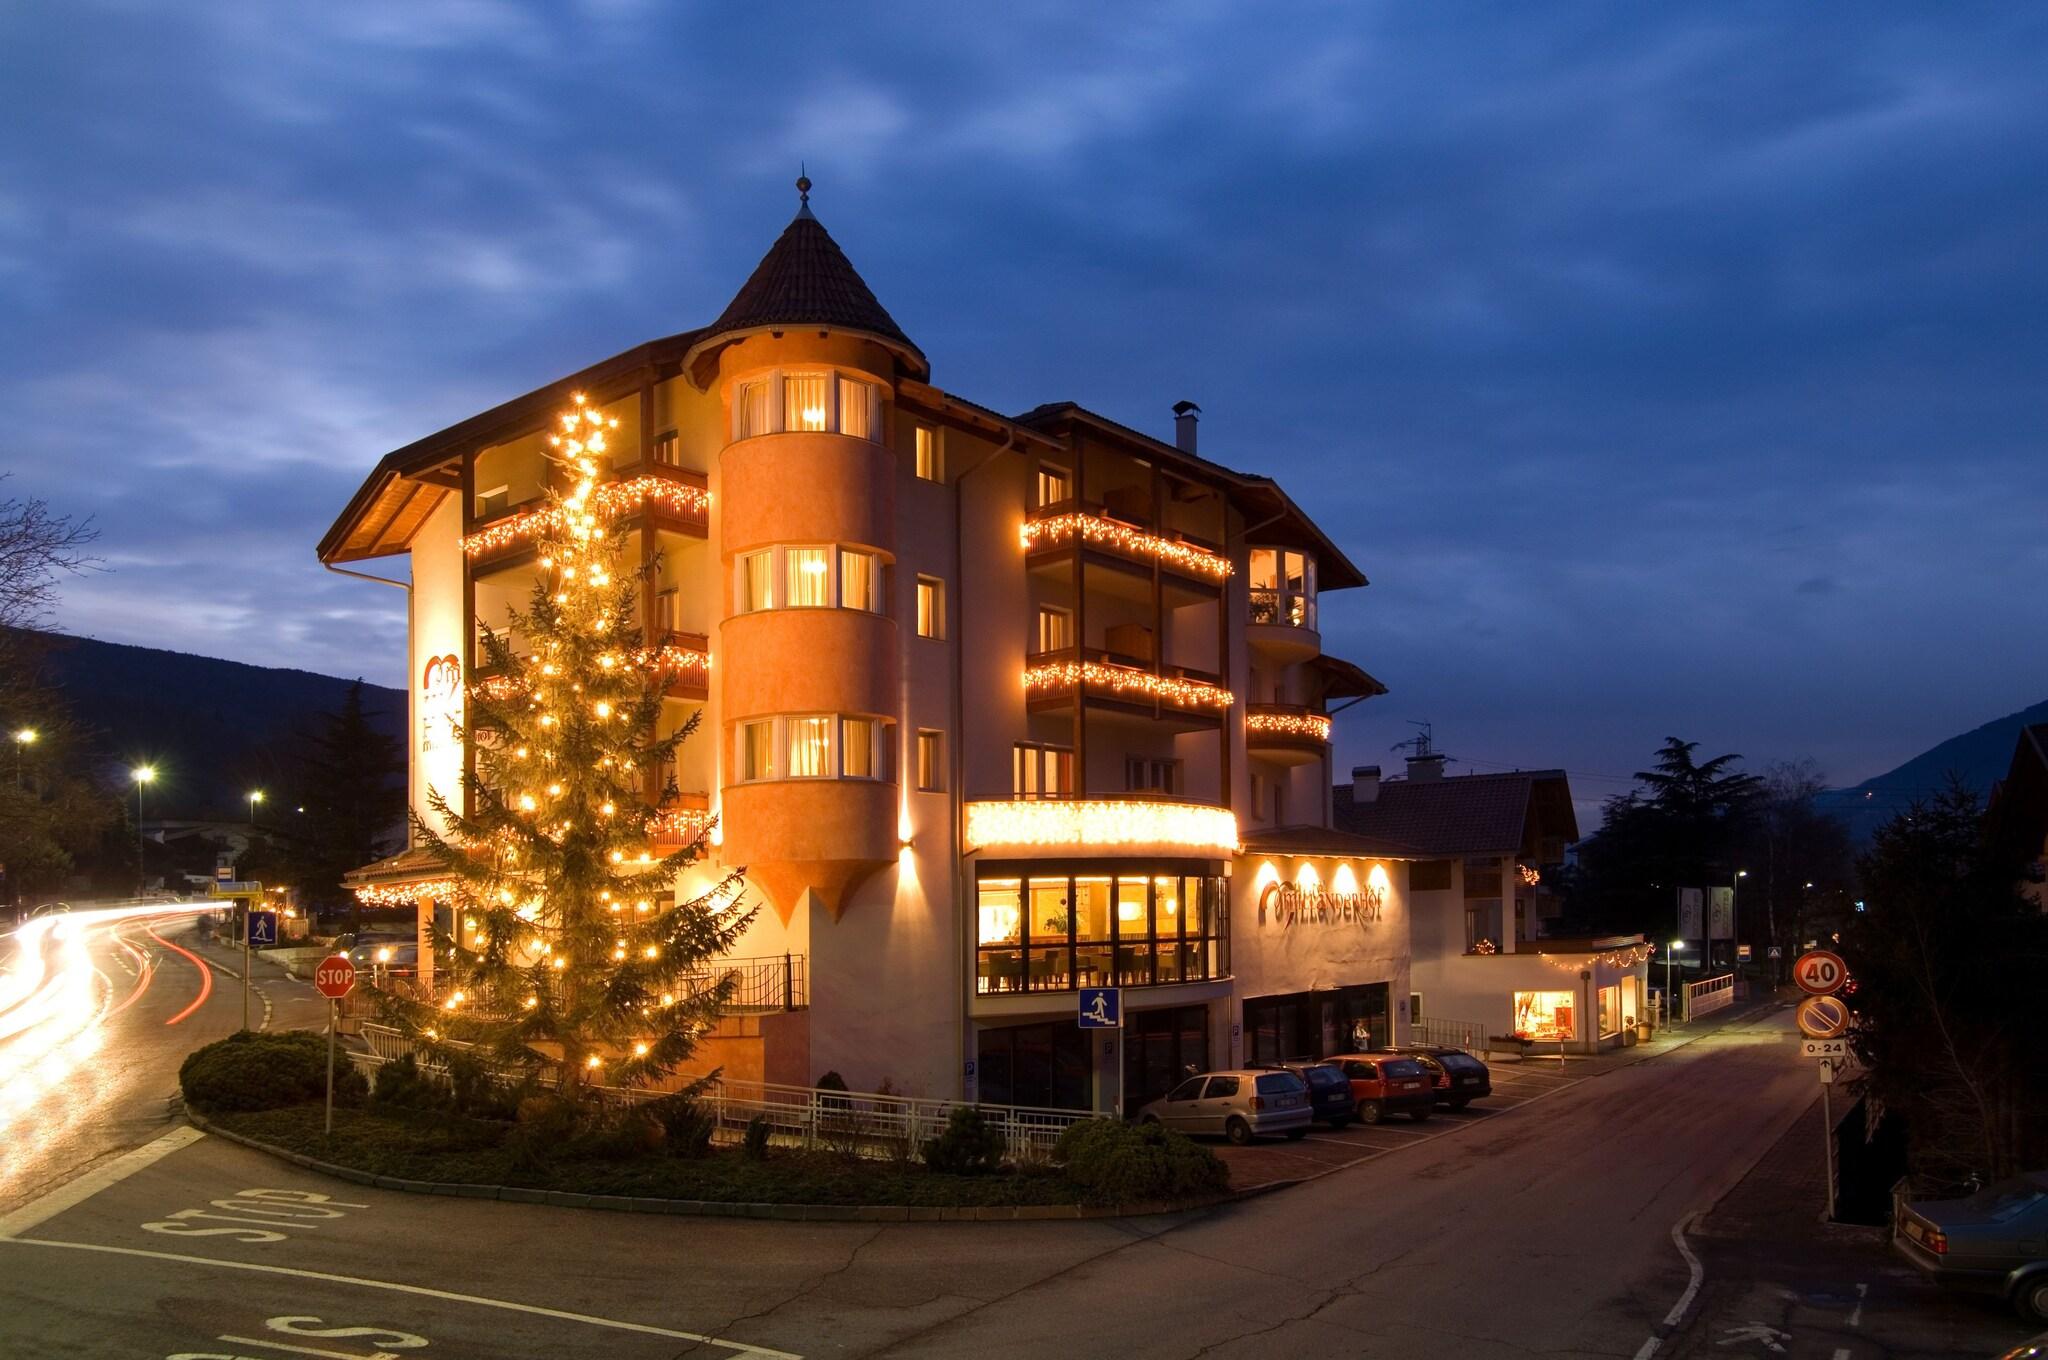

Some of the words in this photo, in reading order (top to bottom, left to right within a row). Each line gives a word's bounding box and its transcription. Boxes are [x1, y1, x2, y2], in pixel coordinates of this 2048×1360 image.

[318, 969, 353, 985] STOP
[1806, 963, 1835, 982] 40
[140, 1188, 371, 1242] STOP
